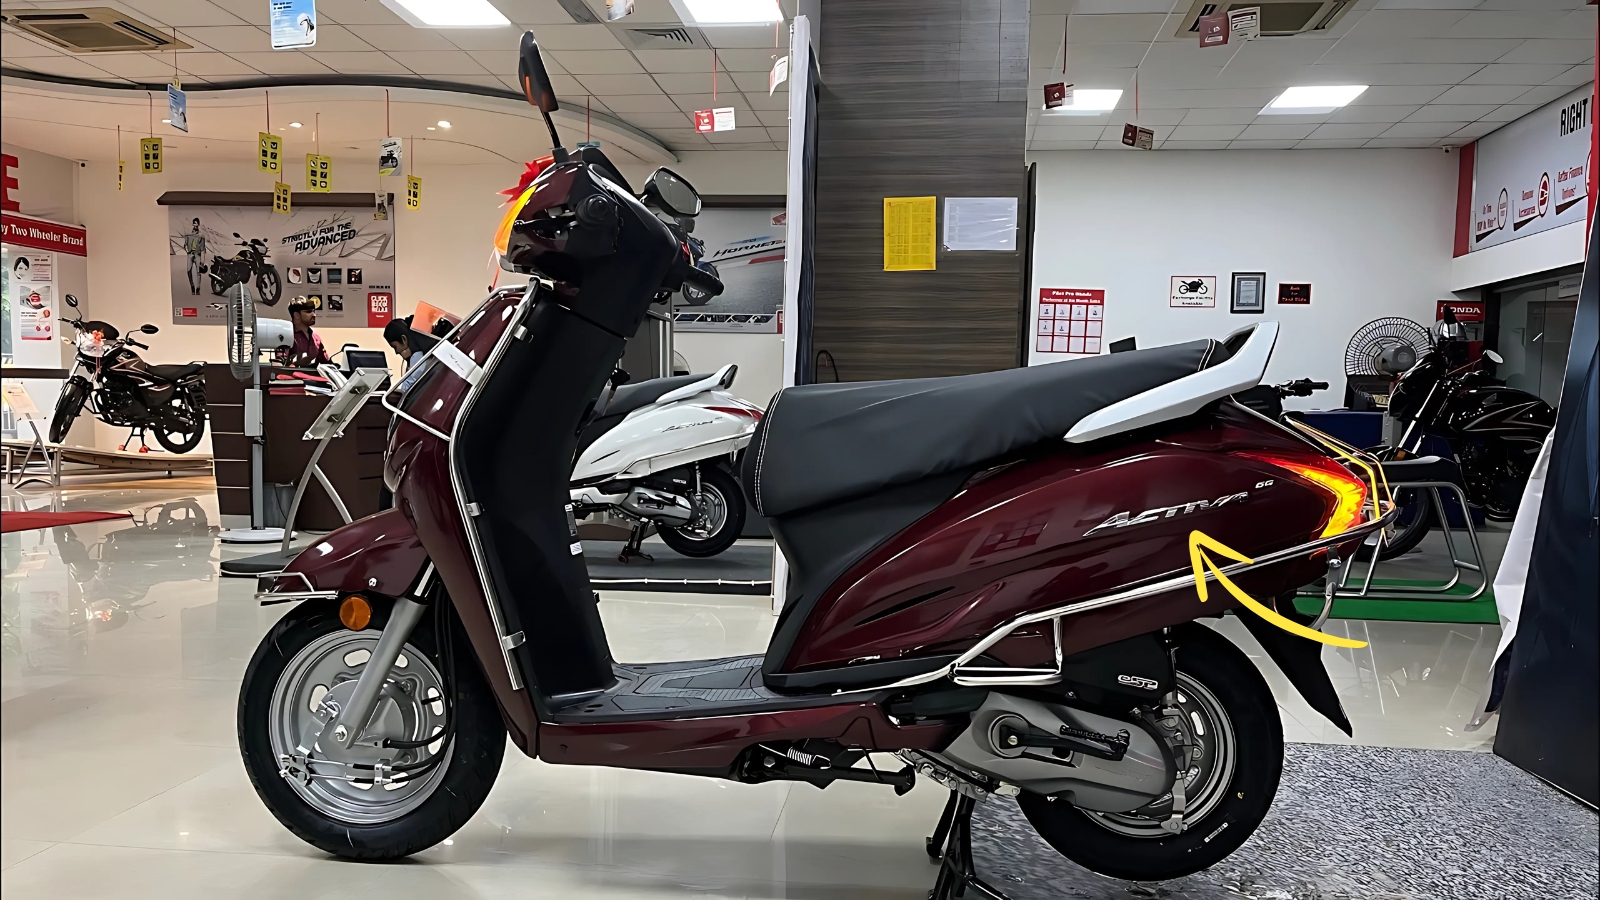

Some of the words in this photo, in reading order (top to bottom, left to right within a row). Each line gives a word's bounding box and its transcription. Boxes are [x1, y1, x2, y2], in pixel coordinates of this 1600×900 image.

[1560, 98, 1588, 137] RIGHT
[10, 224, 28, 237] Two
[29, 227, 61, 242] Wheeler
[62, 233, 84, 246] Brand
[282, 230, 318, 244] STRICTLY
[320, 226, 334, 235] FOR
[337, 222, 351, 231] THE
[295, 229, 356, 253] ADVANCED
[712, 241, 776, 258] HORNET
[1255, 480, 1275, 489] 6G
